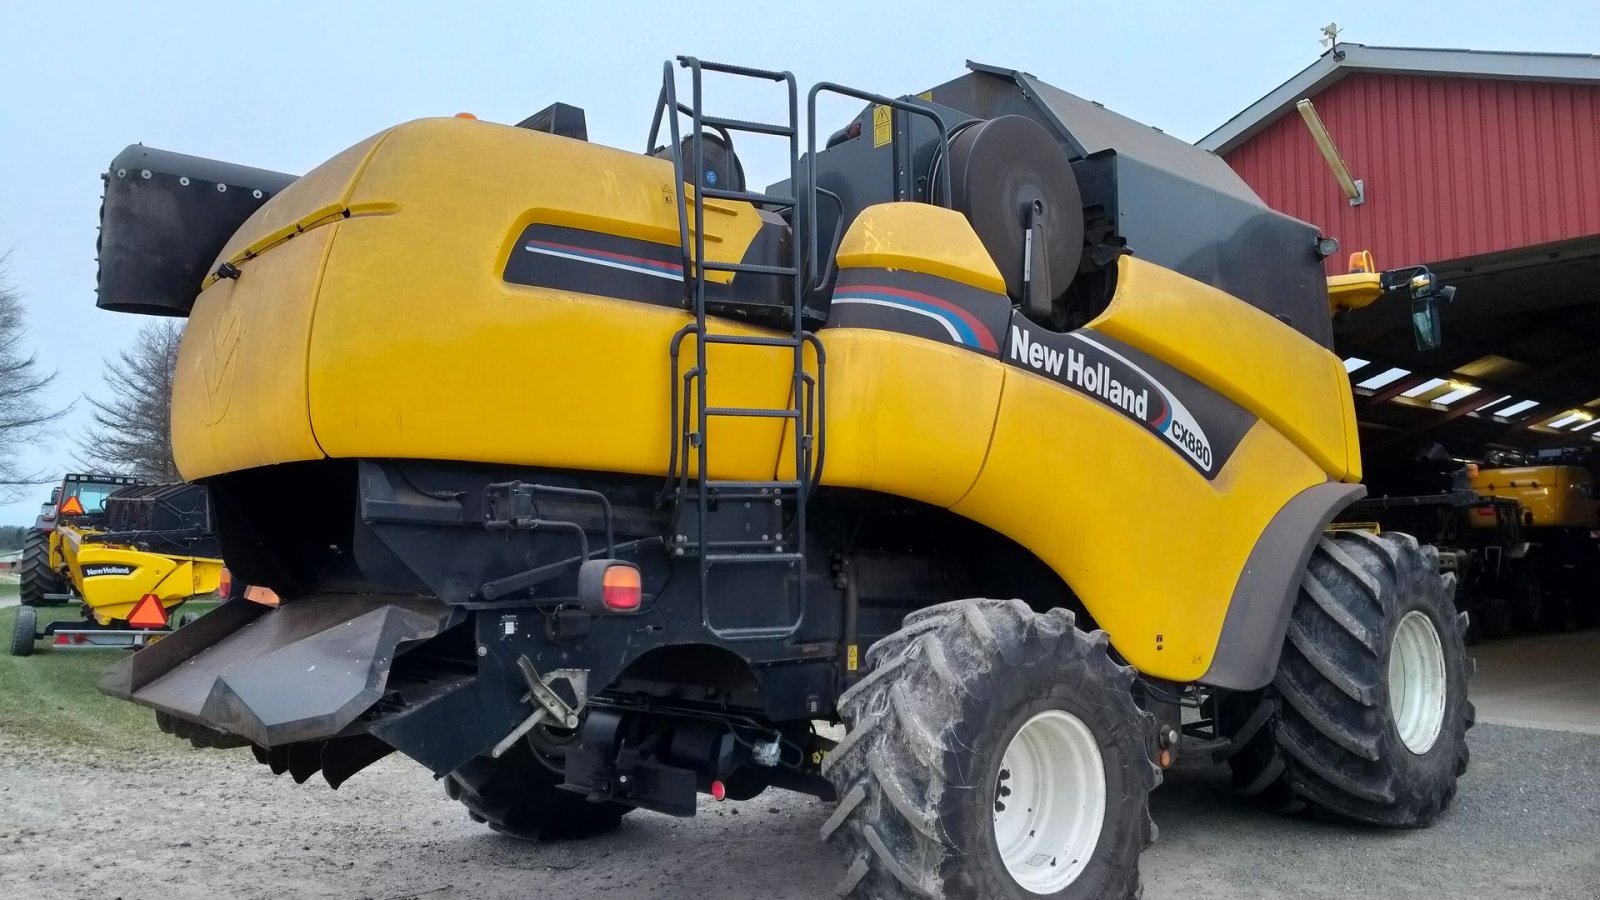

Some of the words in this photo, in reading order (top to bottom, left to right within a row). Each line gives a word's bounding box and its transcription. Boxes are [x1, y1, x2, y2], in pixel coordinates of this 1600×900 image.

[1011, 325, 1064, 376] New
[1067, 348, 1148, 421] Holland
[1172, 420, 1210, 467] CX880
[103, 566, 129, 574] Holland
